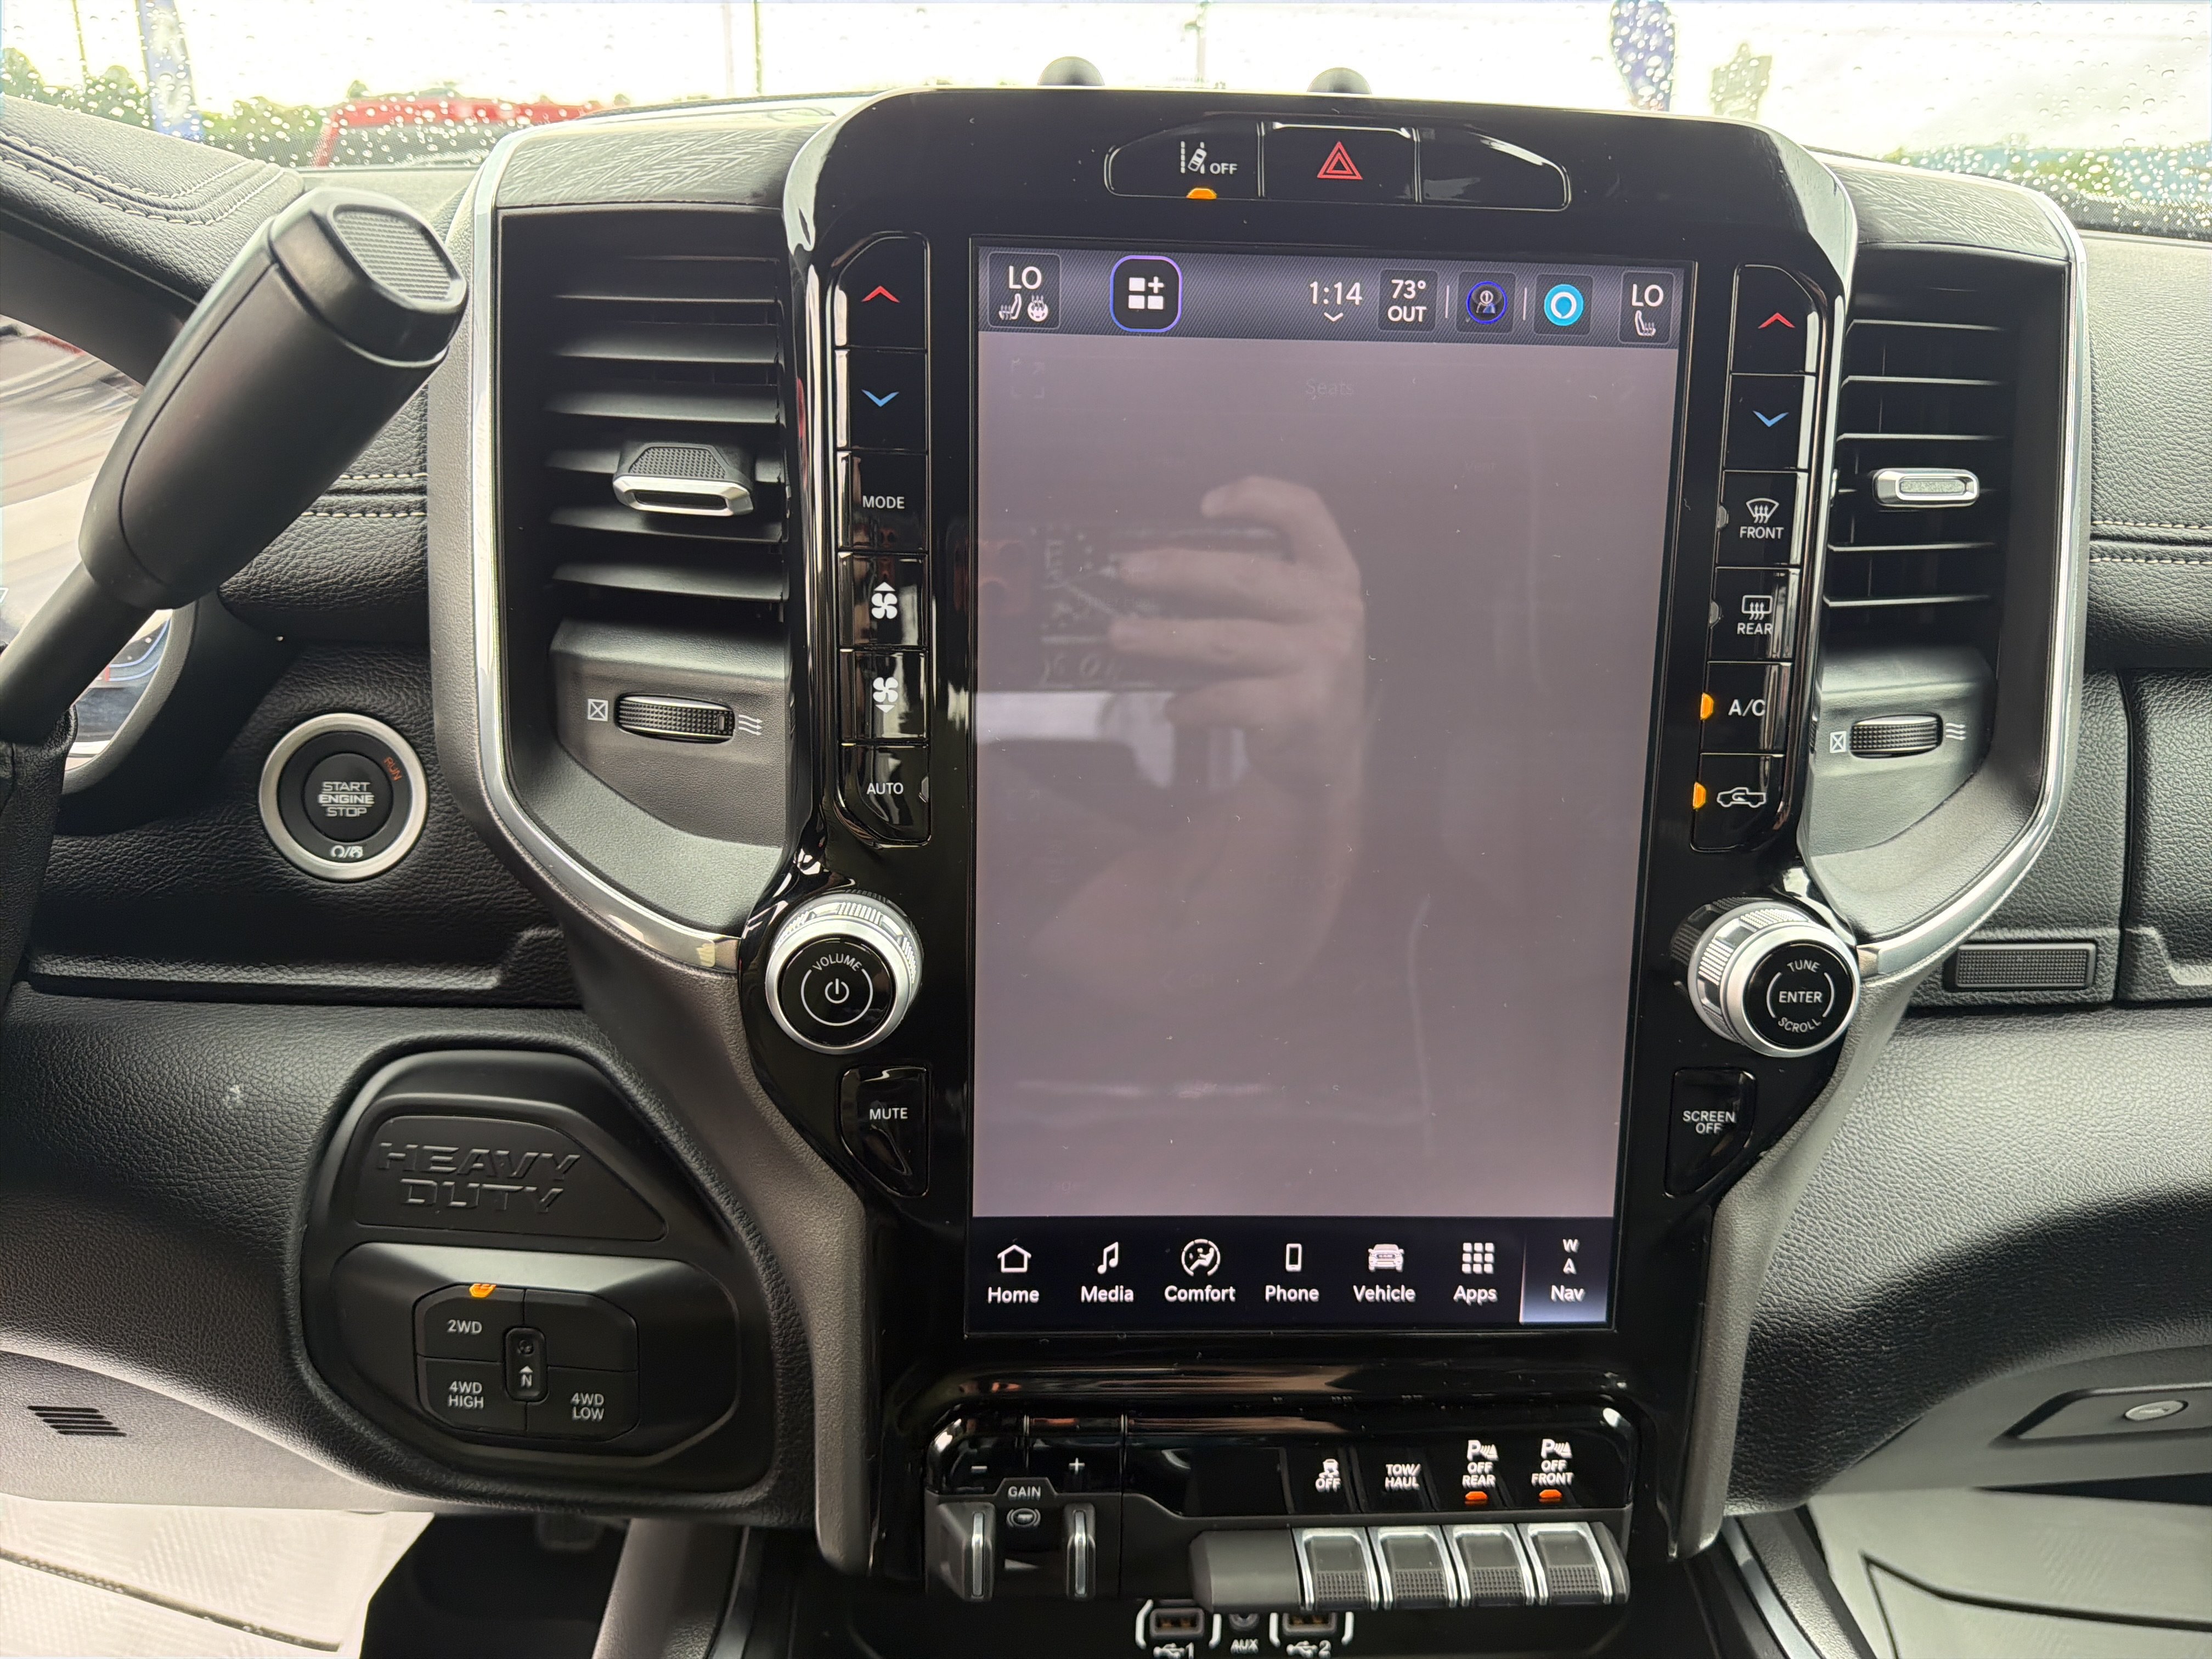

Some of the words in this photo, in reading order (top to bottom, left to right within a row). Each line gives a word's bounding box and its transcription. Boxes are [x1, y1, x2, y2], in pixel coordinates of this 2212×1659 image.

[1210, 162, 1237, 174] OFF
[1008, 266, 1041, 290] LO
[1309, 281, 1362, 305] 1:14
[1632, 284, 1664, 307] LO
[1387, 306, 1426, 324] OUT
[862, 495, 905, 509] MODE
[1740, 527, 1784, 539] FRONT
[1737, 623, 1773, 635] REAR
[1728, 699, 1766, 716] A/C
[385, 757, 402, 781] RUN
[321, 781, 370, 791] START
[867, 783, 904, 794] AUTO
[318, 794, 375, 804] ENGINE
[326, 806, 367, 817] STOP
[811, 953, 862, 972] VOLUME
[1786, 960, 1820, 973] TUNE
[1779, 991, 1822, 1003] ENTER
[1778, 1017, 1821, 1033] SCROLL
[870, 1108, 908, 1120] MUTE
[1682, 1110, 1736, 1122] SCREEN
[1695, 1123, 1723, 1134] OFF
[377, 1143, 580, 1180] HEAVY
[400, 1178, 563, 1212] DUTY
[987, 1287, 1040, 1304] Home
[1081, 1286, 1134, 1303] Media
[1164, 1286, 1236, 1304] Comfort
[1265, 1286, 1319, 1303] Phone
[1353, 1285, 1415, 1302] Vehicle
[1453, 1285, 1498, 1305] Apps
[1551, 1285, 1585, 1302] Nav
[448, 1319, 482, 1334] 2WD
[449, 1381, 482, 1394] 4WD
[521, 1374, 532, 1388] N
[448, 1395, 484, 1408] HIGH
[571, 1393, 604, 1406] 4WD
[572, 1407, 604, 1420] LOW
[1386, 1463, 1421, 1477] TOW/
[1467, 1462, 1493, 1474] OFF
[1541, 1460, 1567, 1472] OFF
[1316, 1479, 1341, 1492] OFF
[1385, 1477, 1420, 1489] HAUL
[1463, 1475, 1496, 1487] REAR
[1531, 1472, 1574, 1485] FRONT
[1008, 1486, 1041, 1500] GAIN
[1231, 1639, 1259, 1654] AUX
